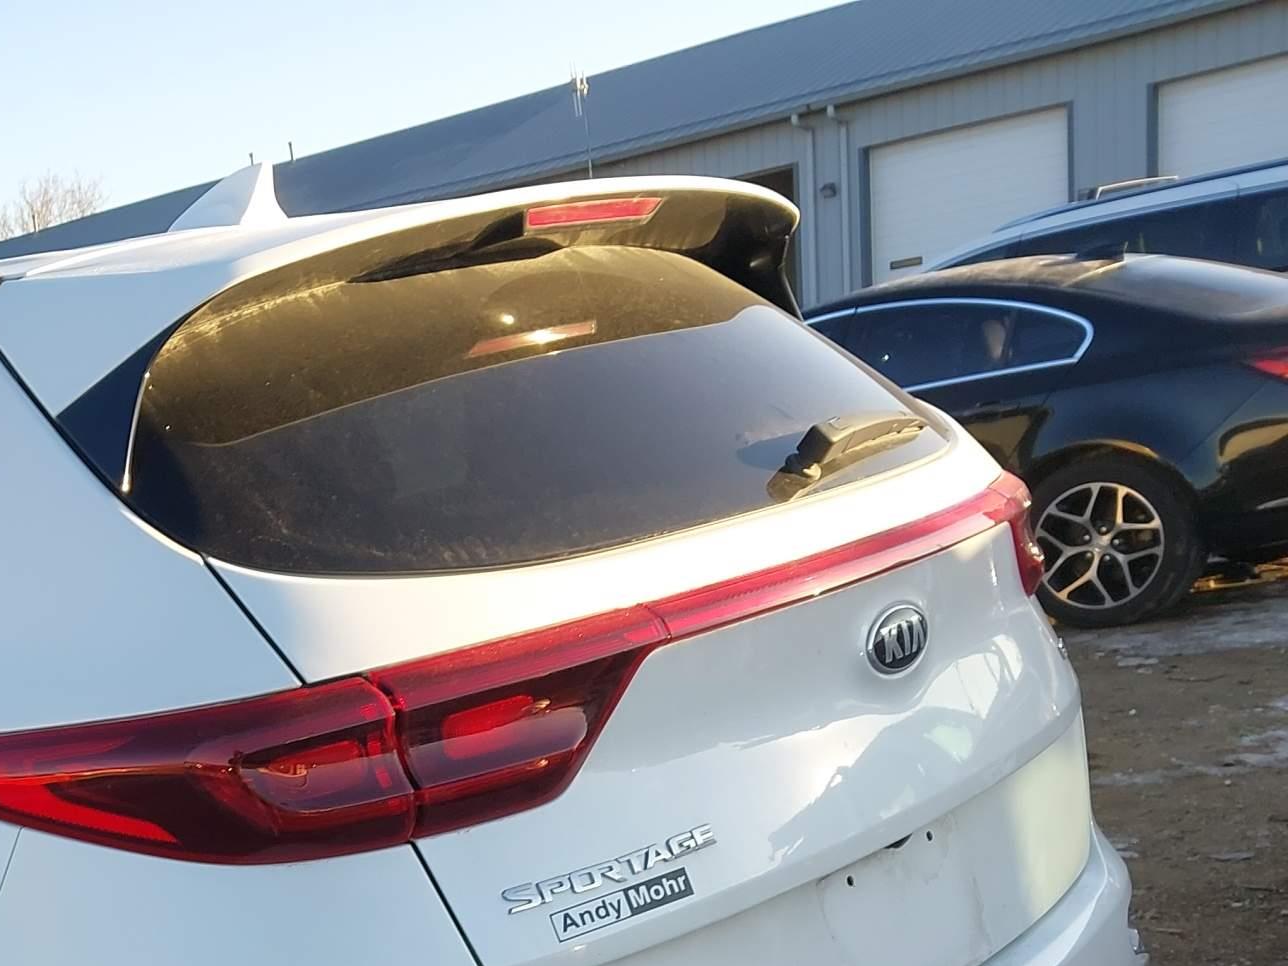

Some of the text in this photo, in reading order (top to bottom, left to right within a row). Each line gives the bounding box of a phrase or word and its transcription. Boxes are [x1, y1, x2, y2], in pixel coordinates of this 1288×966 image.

[879, 614, 926, 664] KIA
[501, 822, 718, 915] SPORTAGE
[562, 873, 688, 933] Andy Mohr
